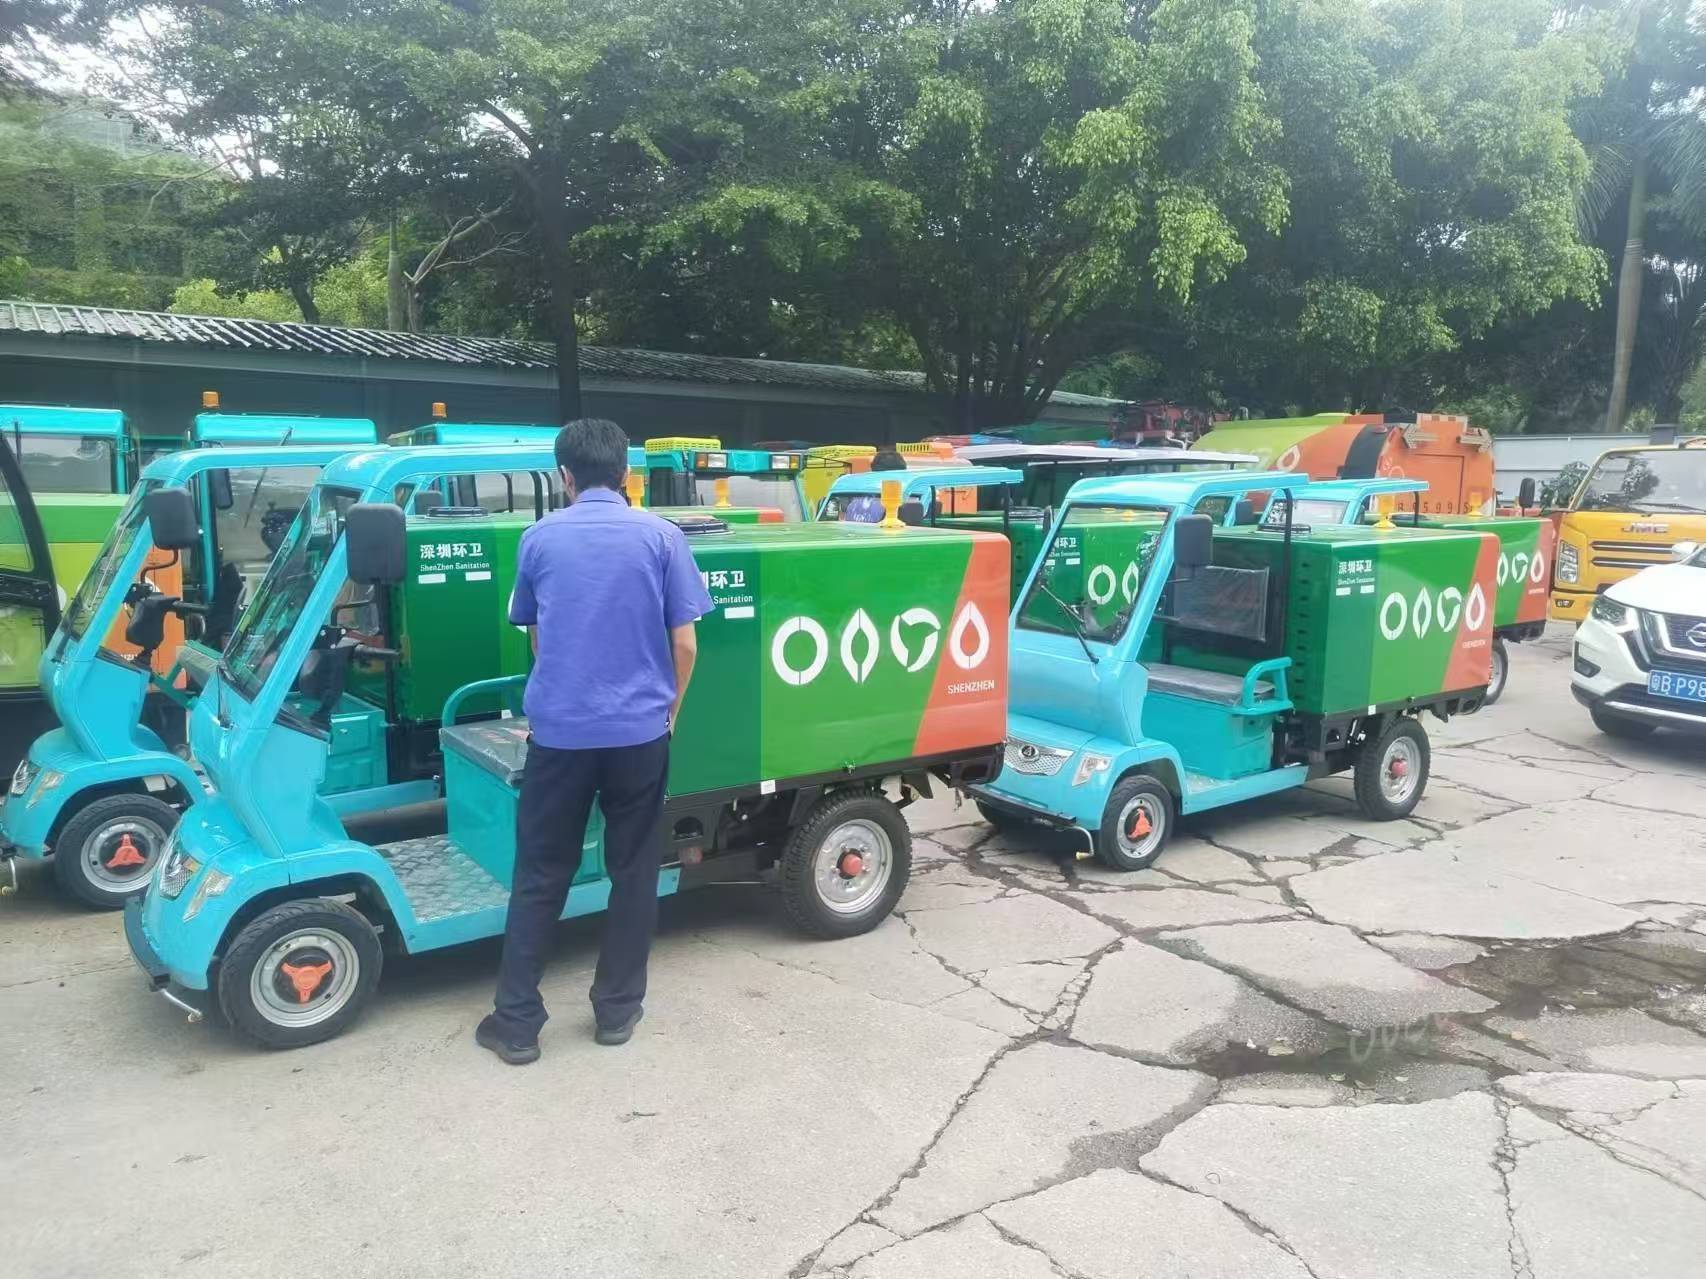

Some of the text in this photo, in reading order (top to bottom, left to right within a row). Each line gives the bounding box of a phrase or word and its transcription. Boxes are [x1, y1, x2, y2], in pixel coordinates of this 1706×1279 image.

[420, 543, 483, 559] 深圳环卫
[455, 562, 490, 570] Sanitation
[713, 594, 753, 604] Sanitation
[947, 680, 995, 694] SHENZHEN
